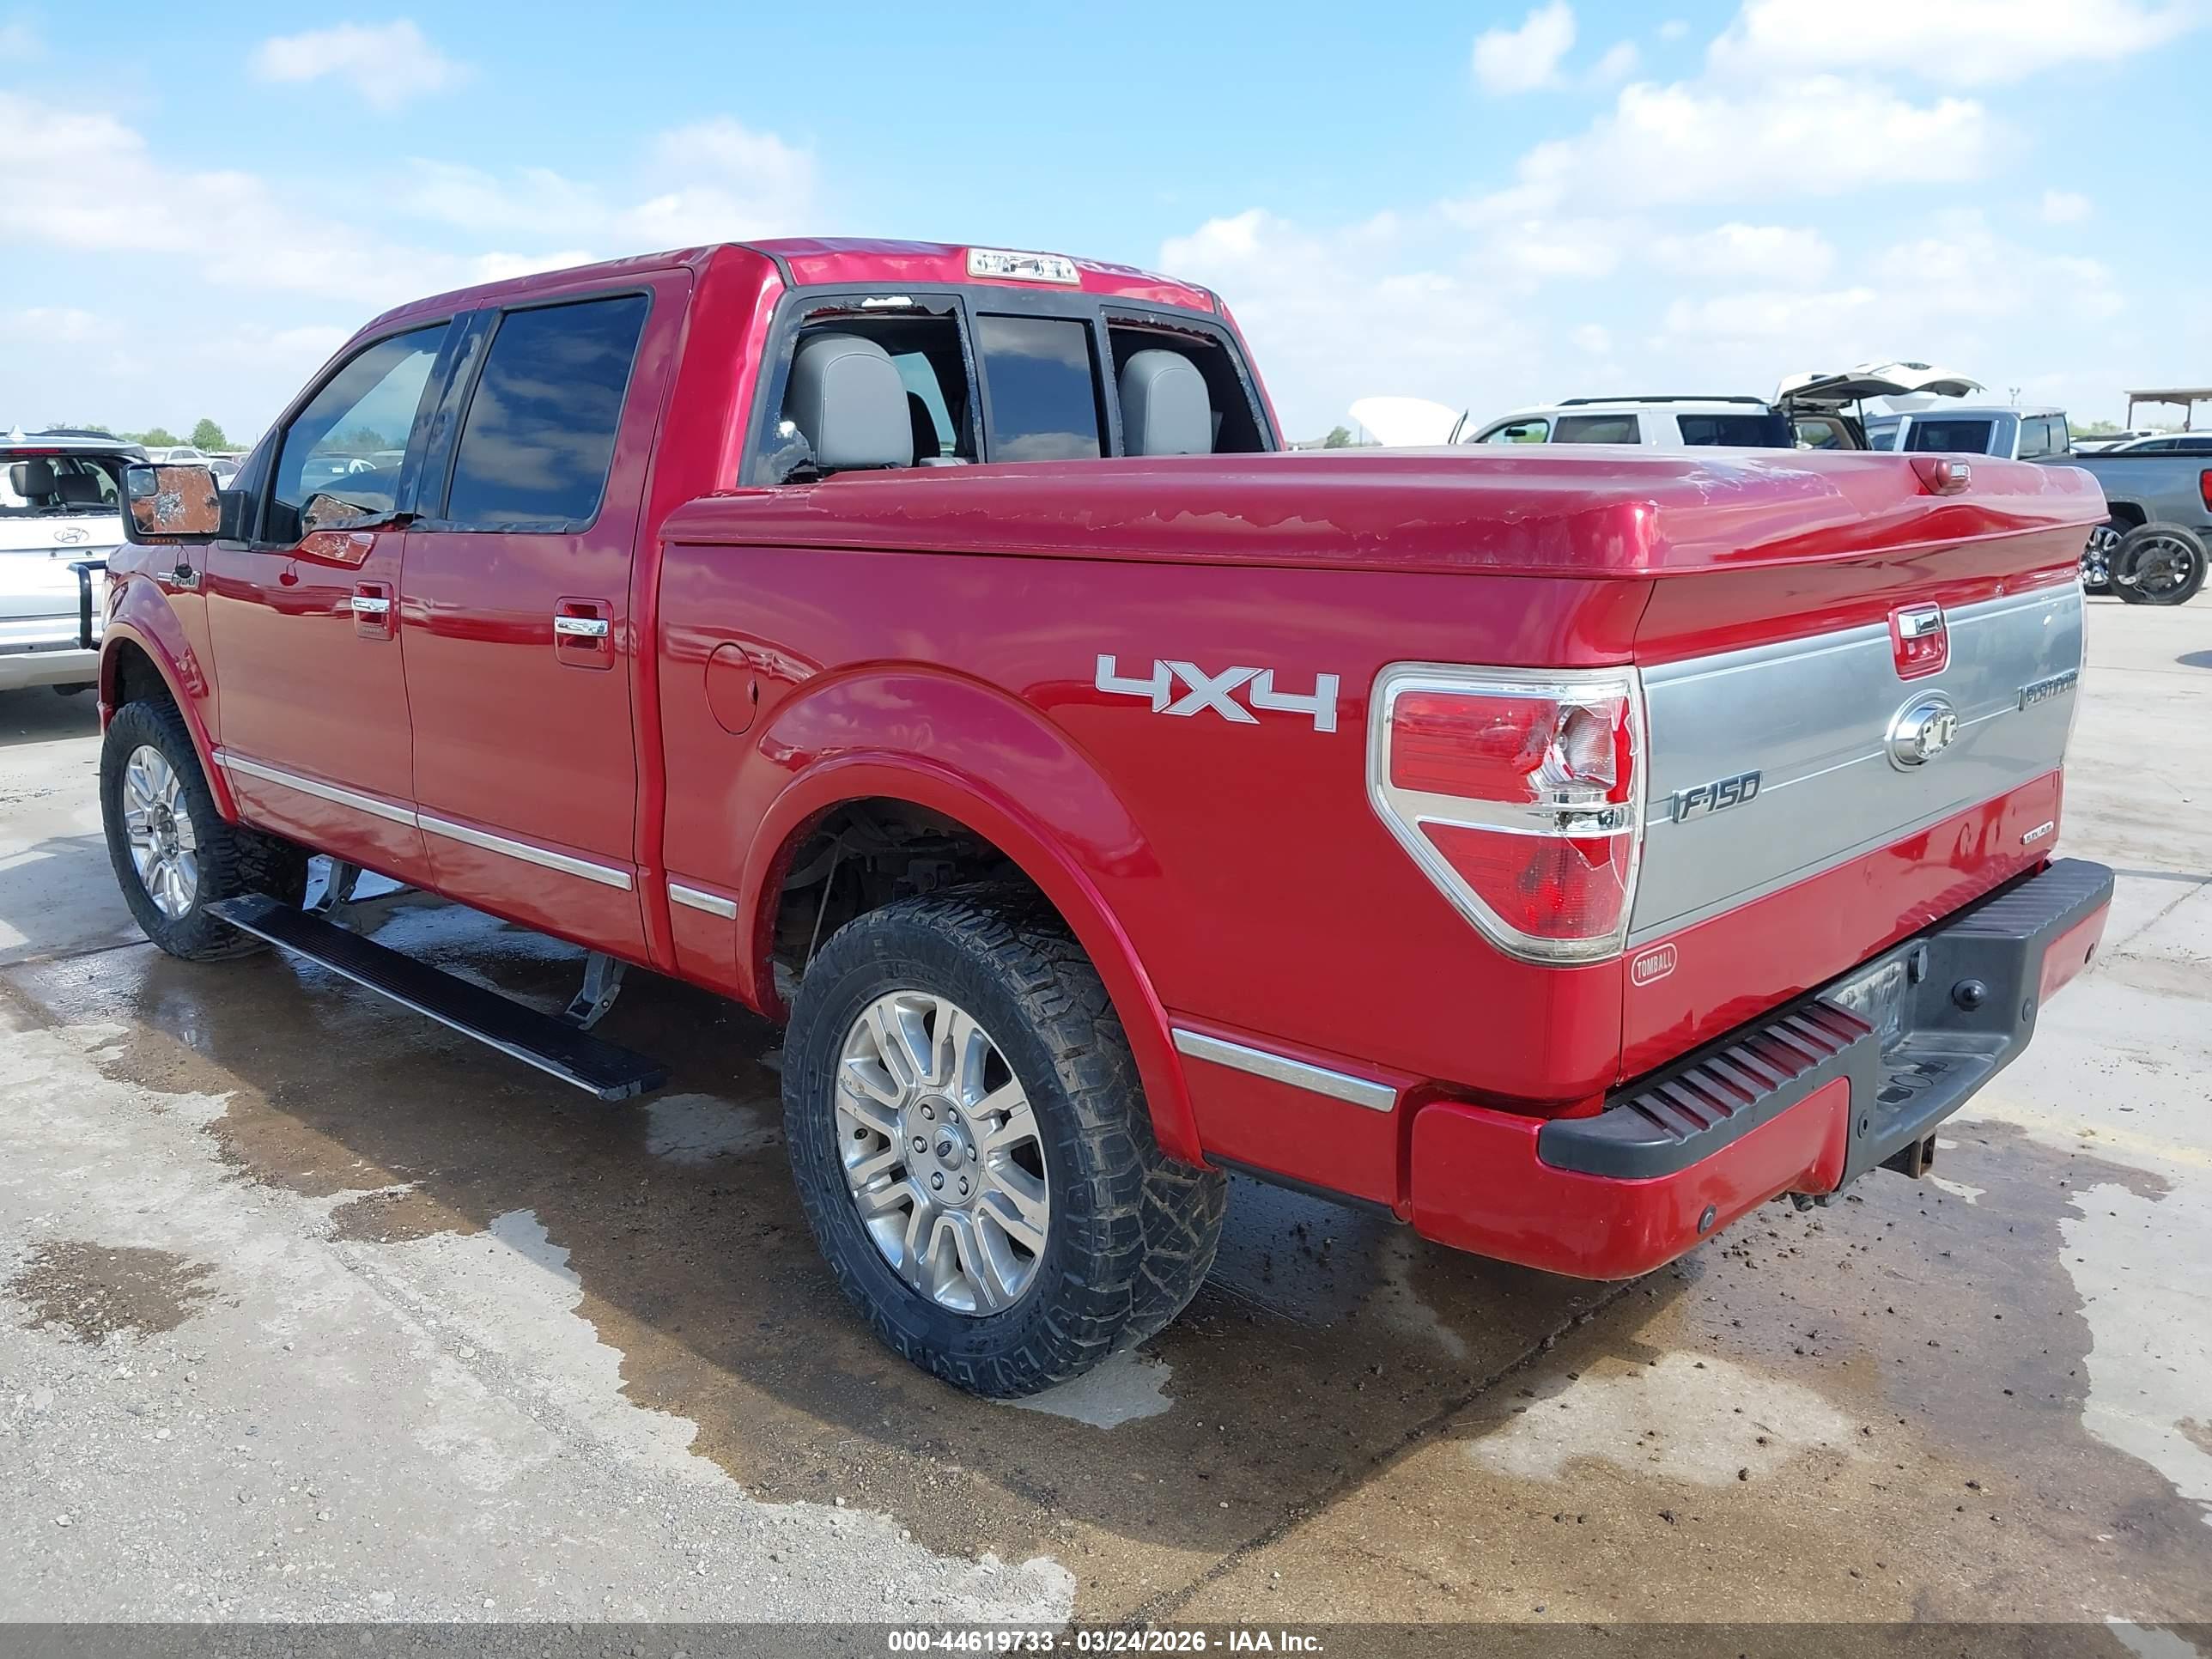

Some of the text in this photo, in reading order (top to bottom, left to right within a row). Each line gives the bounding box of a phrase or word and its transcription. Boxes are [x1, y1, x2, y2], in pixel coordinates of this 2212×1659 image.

[1096, 654, 1340, 732] 4X4
[1679, 769, 1760, 819] F-150
[1637, 951, 1672, 979] TOMBALL
